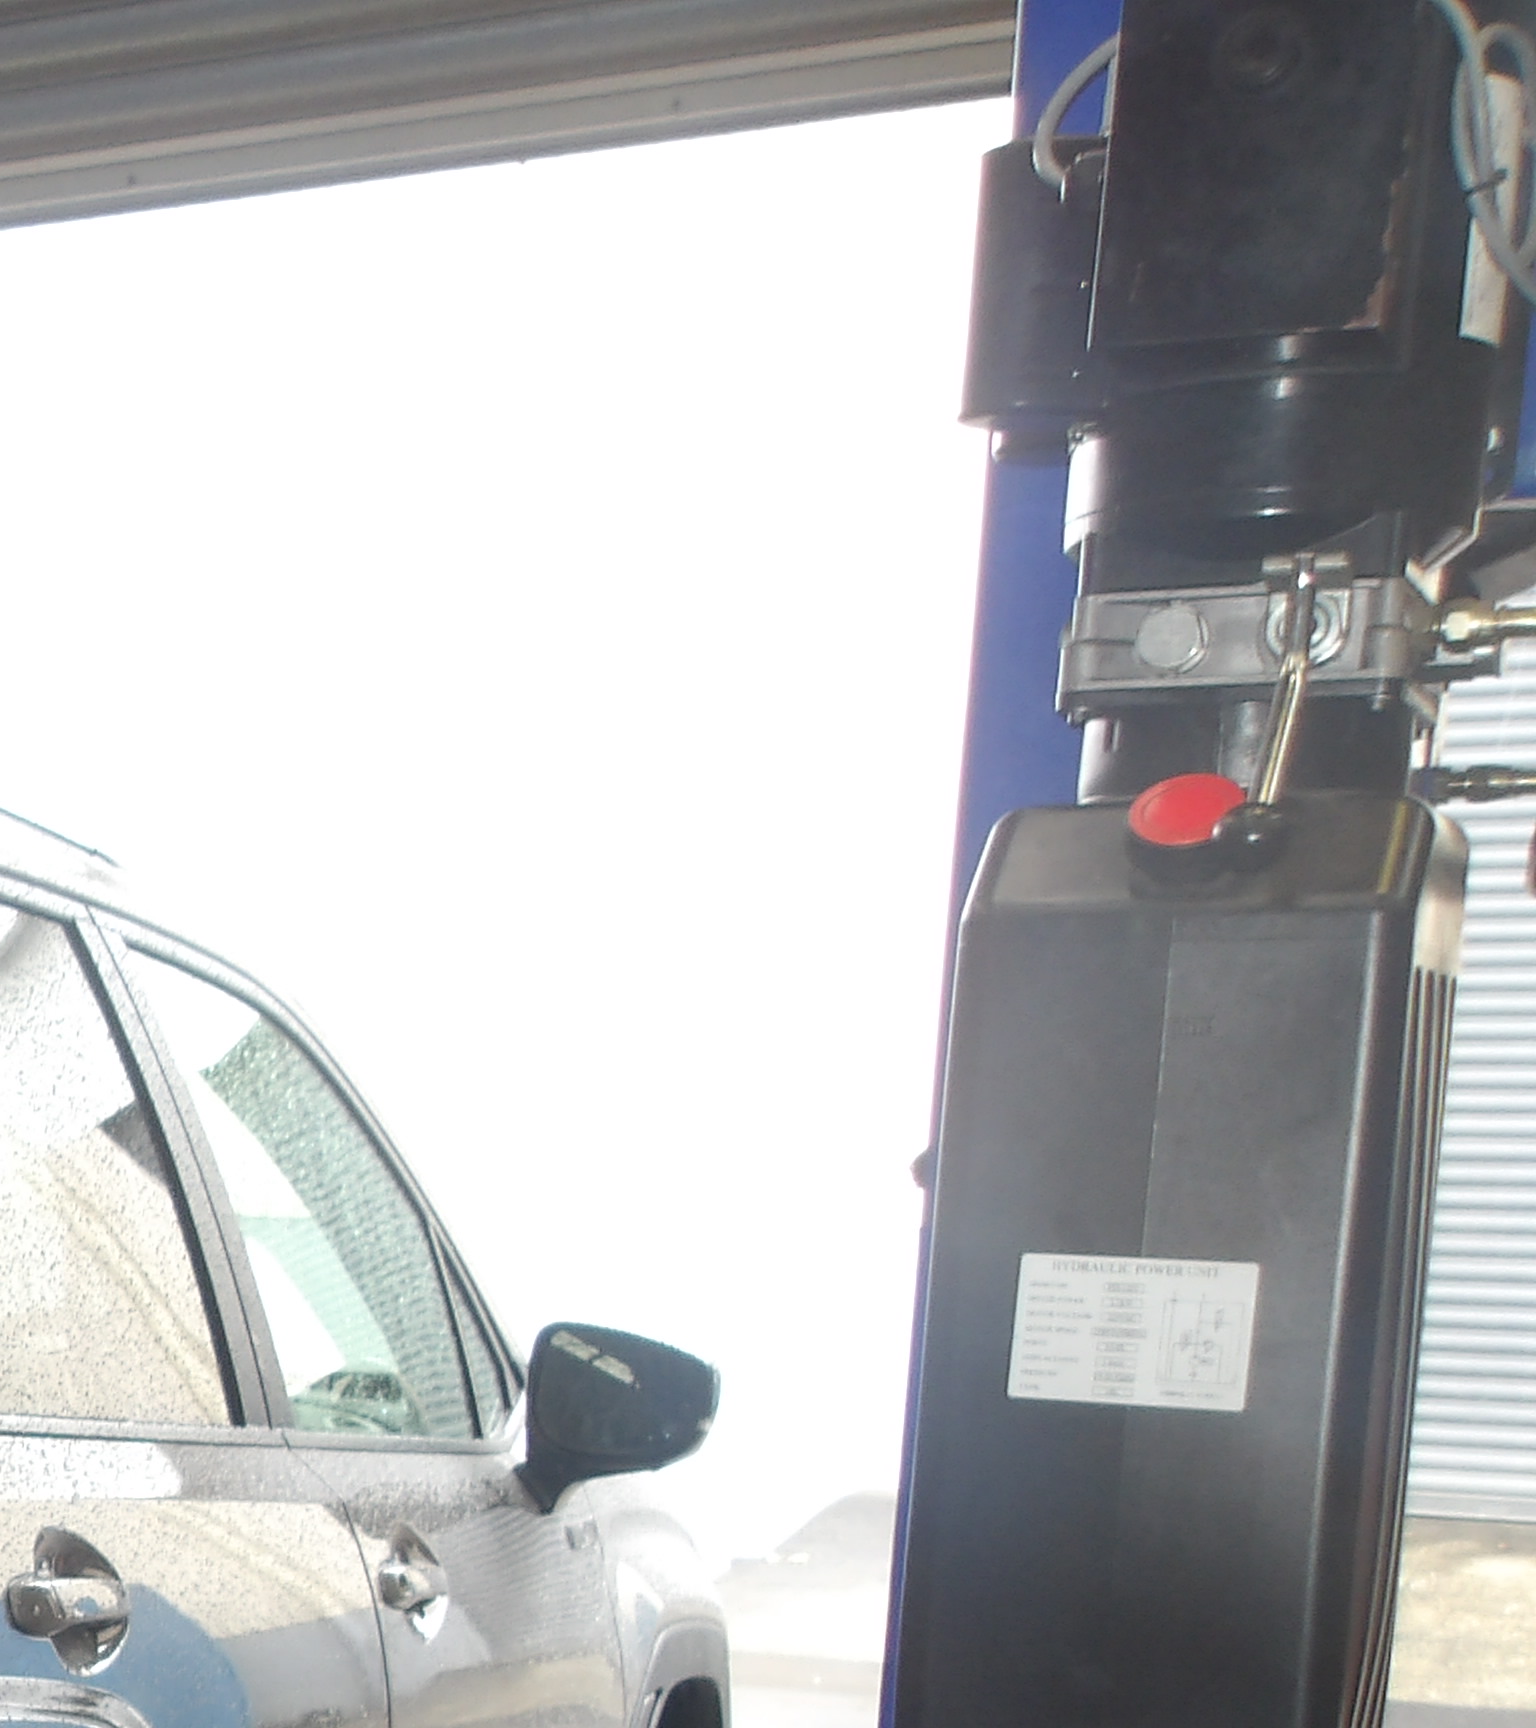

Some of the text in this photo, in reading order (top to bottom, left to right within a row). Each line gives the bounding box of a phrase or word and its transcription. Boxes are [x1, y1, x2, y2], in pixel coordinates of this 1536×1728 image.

[1052, 1260, 1219, 1279] HYDRAULIC POWER UNIT
